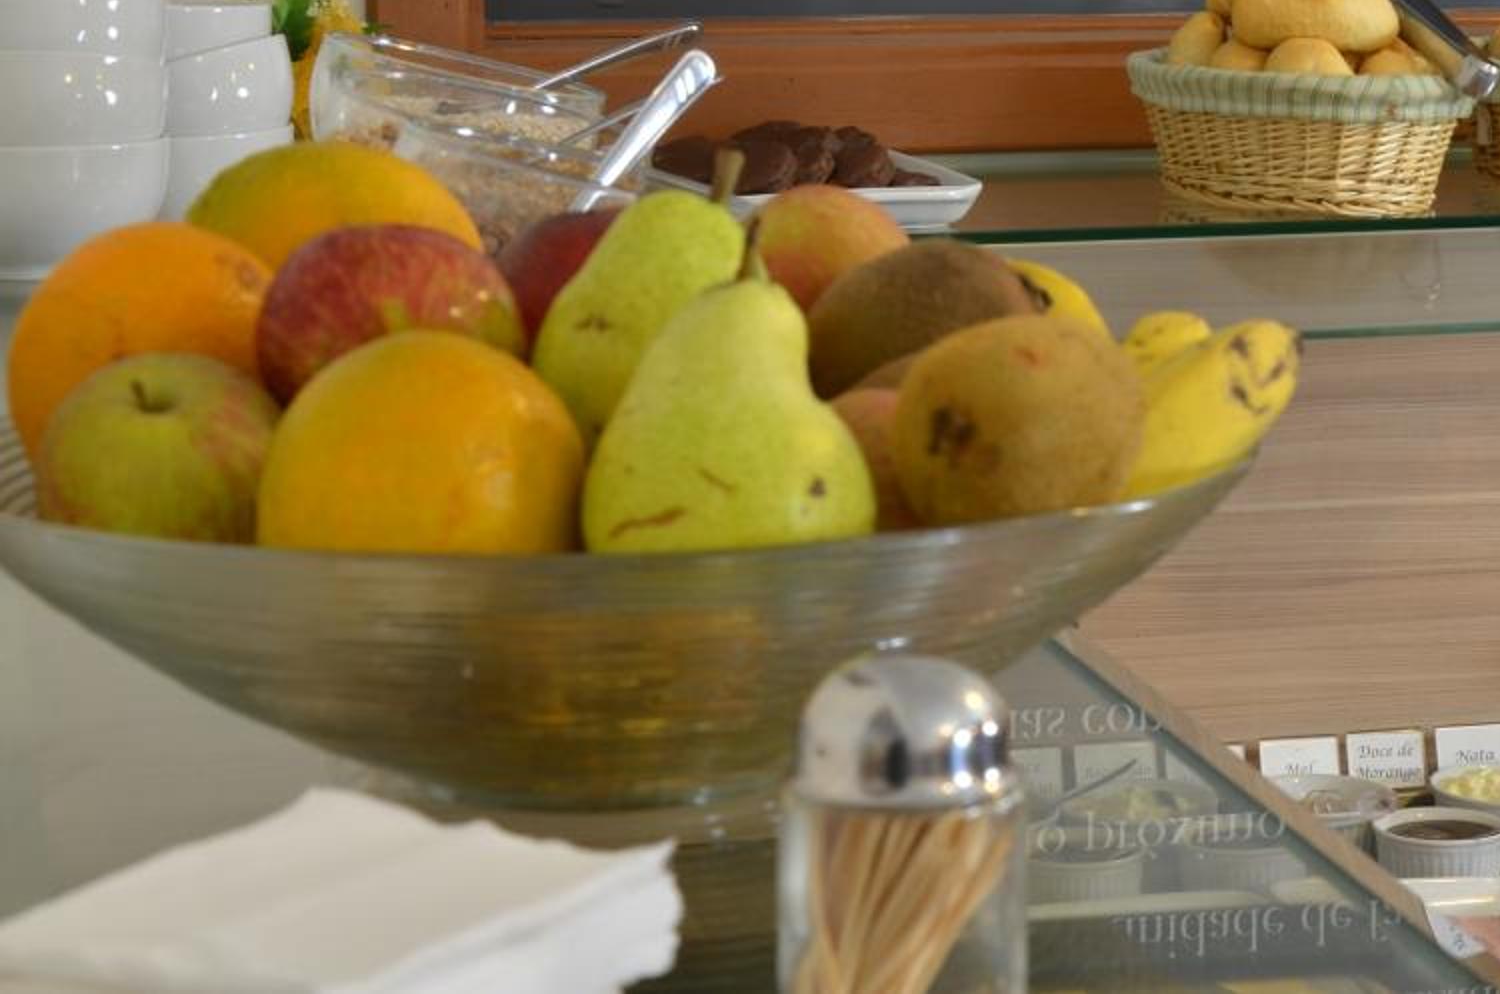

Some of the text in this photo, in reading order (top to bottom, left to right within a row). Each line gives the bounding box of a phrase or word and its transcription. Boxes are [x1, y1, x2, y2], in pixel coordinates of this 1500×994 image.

[1359, 744, 1415, 759] Doce de
[1456, 750, 1496, 763] Nata
